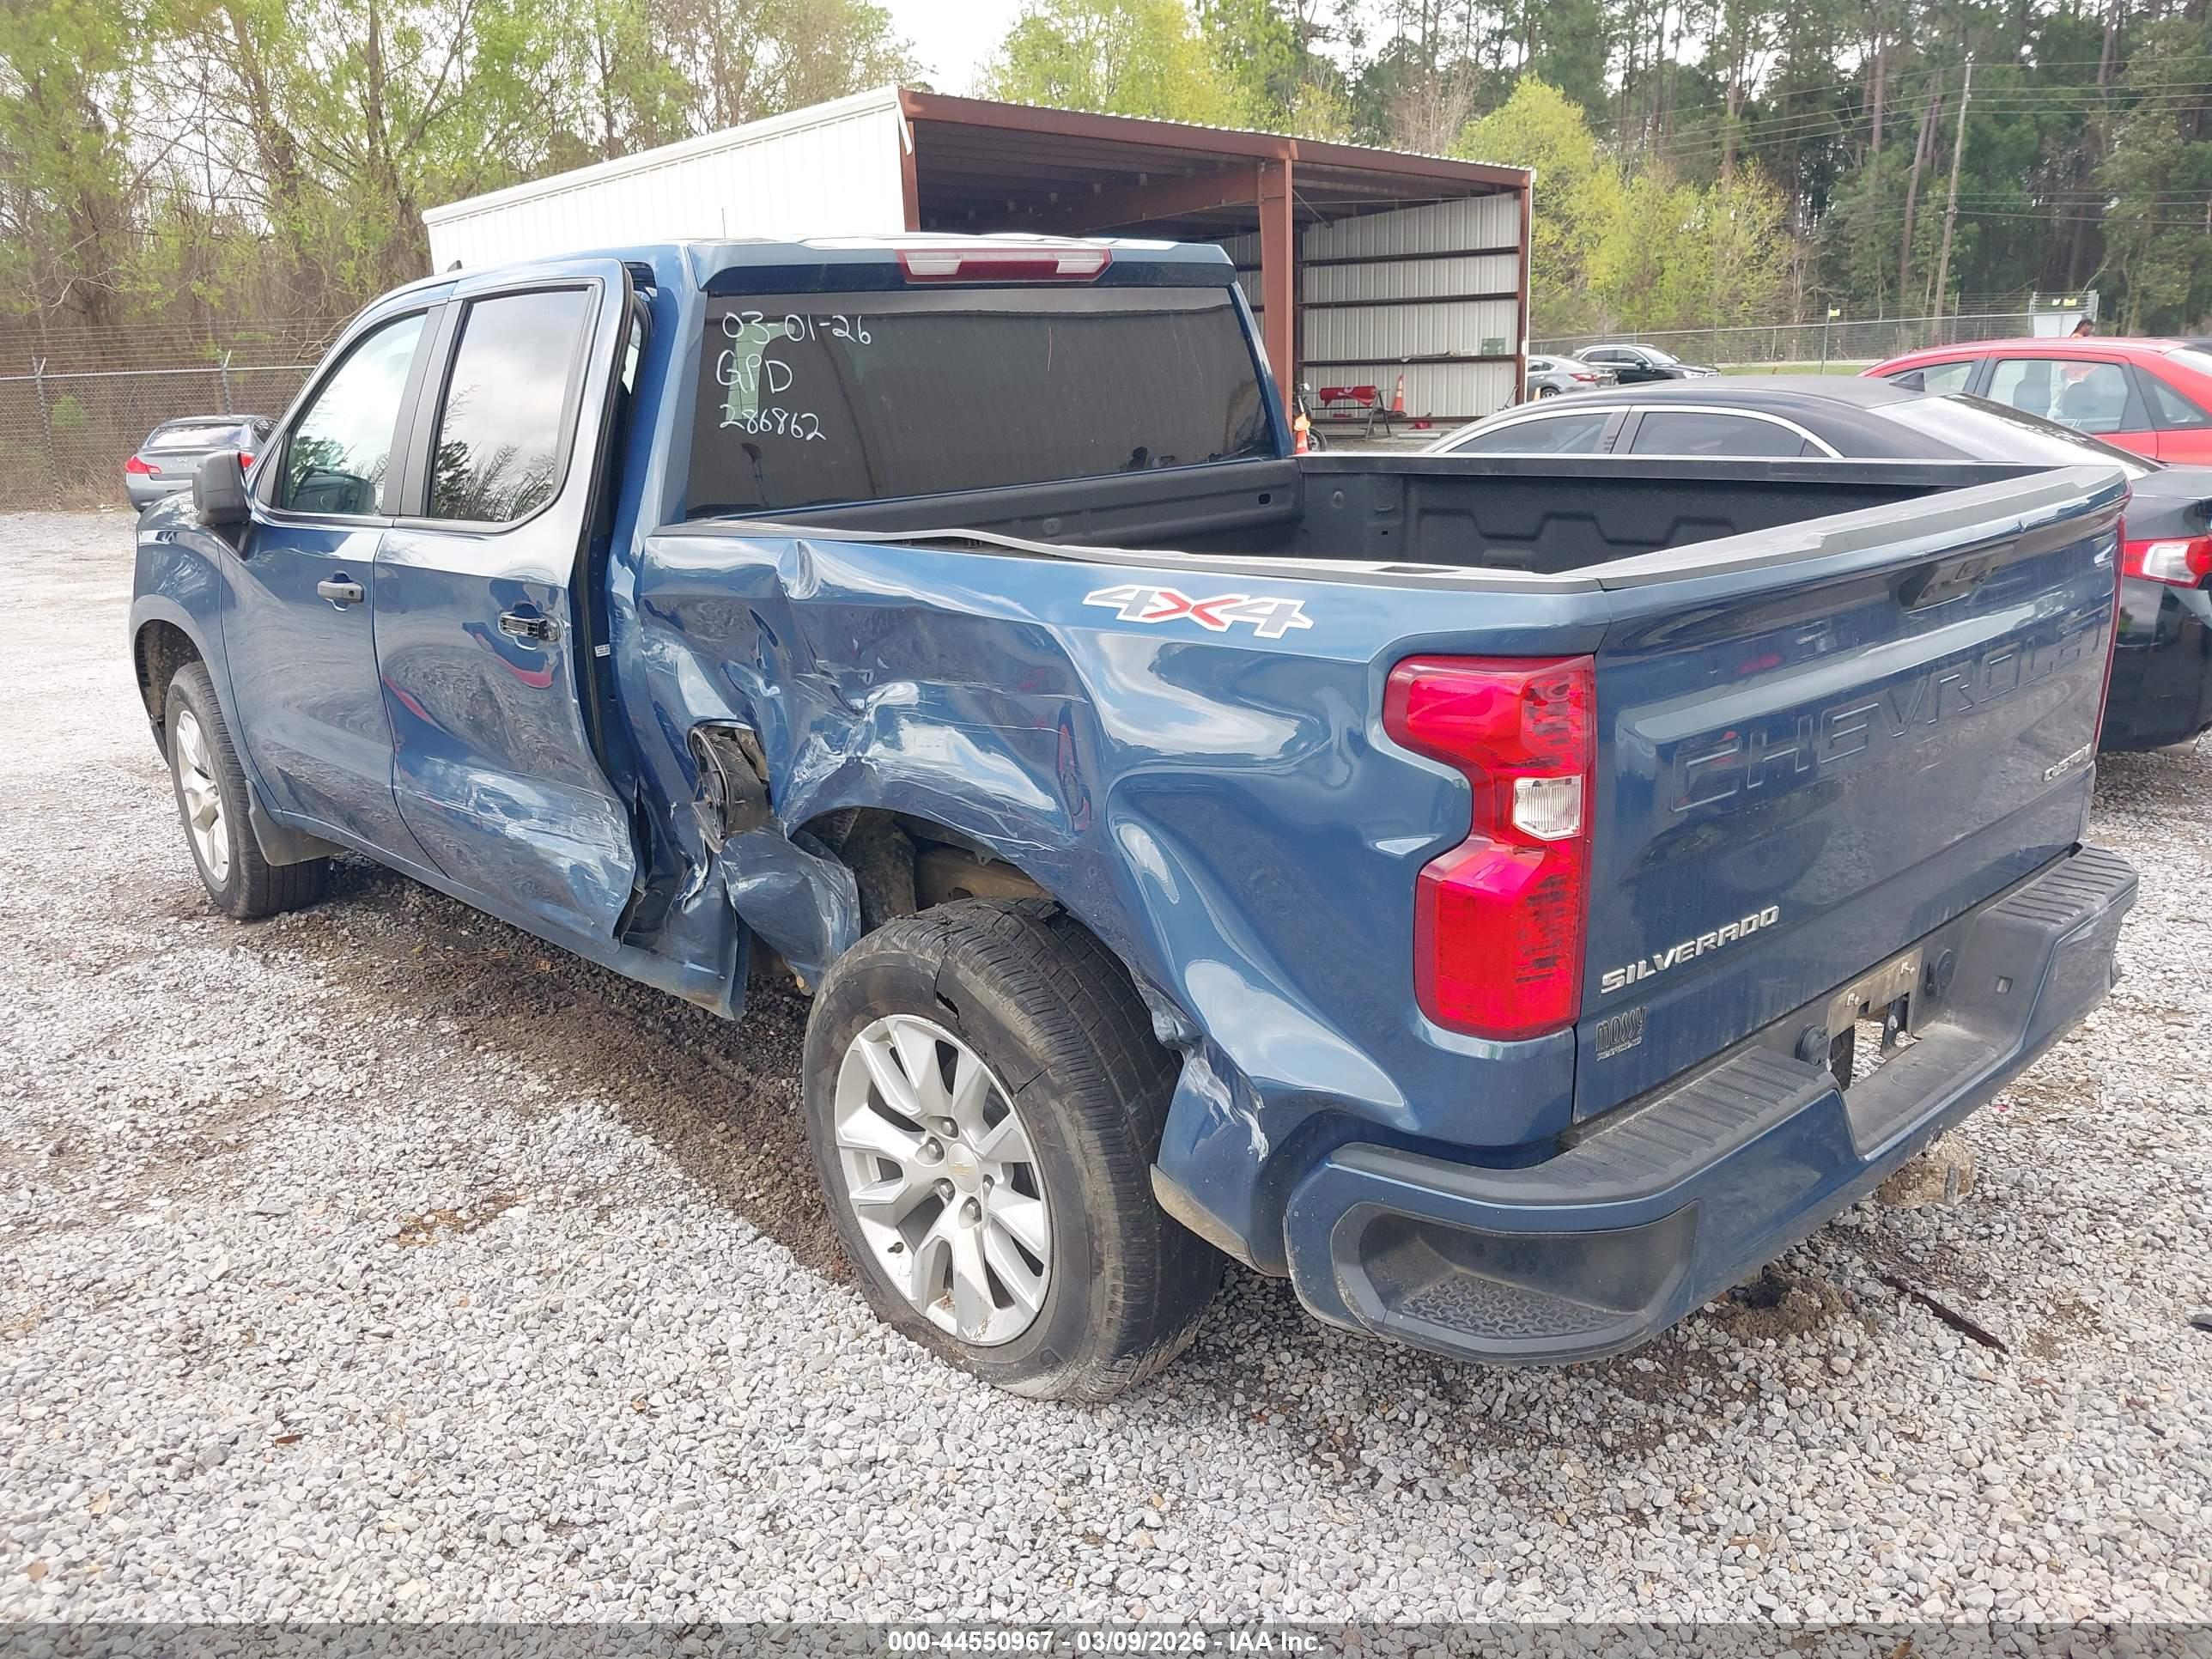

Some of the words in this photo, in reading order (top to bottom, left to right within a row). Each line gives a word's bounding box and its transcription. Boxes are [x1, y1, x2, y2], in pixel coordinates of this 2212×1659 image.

[722, 311, 872, 345] 03-01-26
[716, 349, 793, 393] GPD
[719, 404, 827, 441] 286862
[1670, 601, 2111, 812] CHEVROLET
[1601, 905, 1780, 994] SILVERADO
